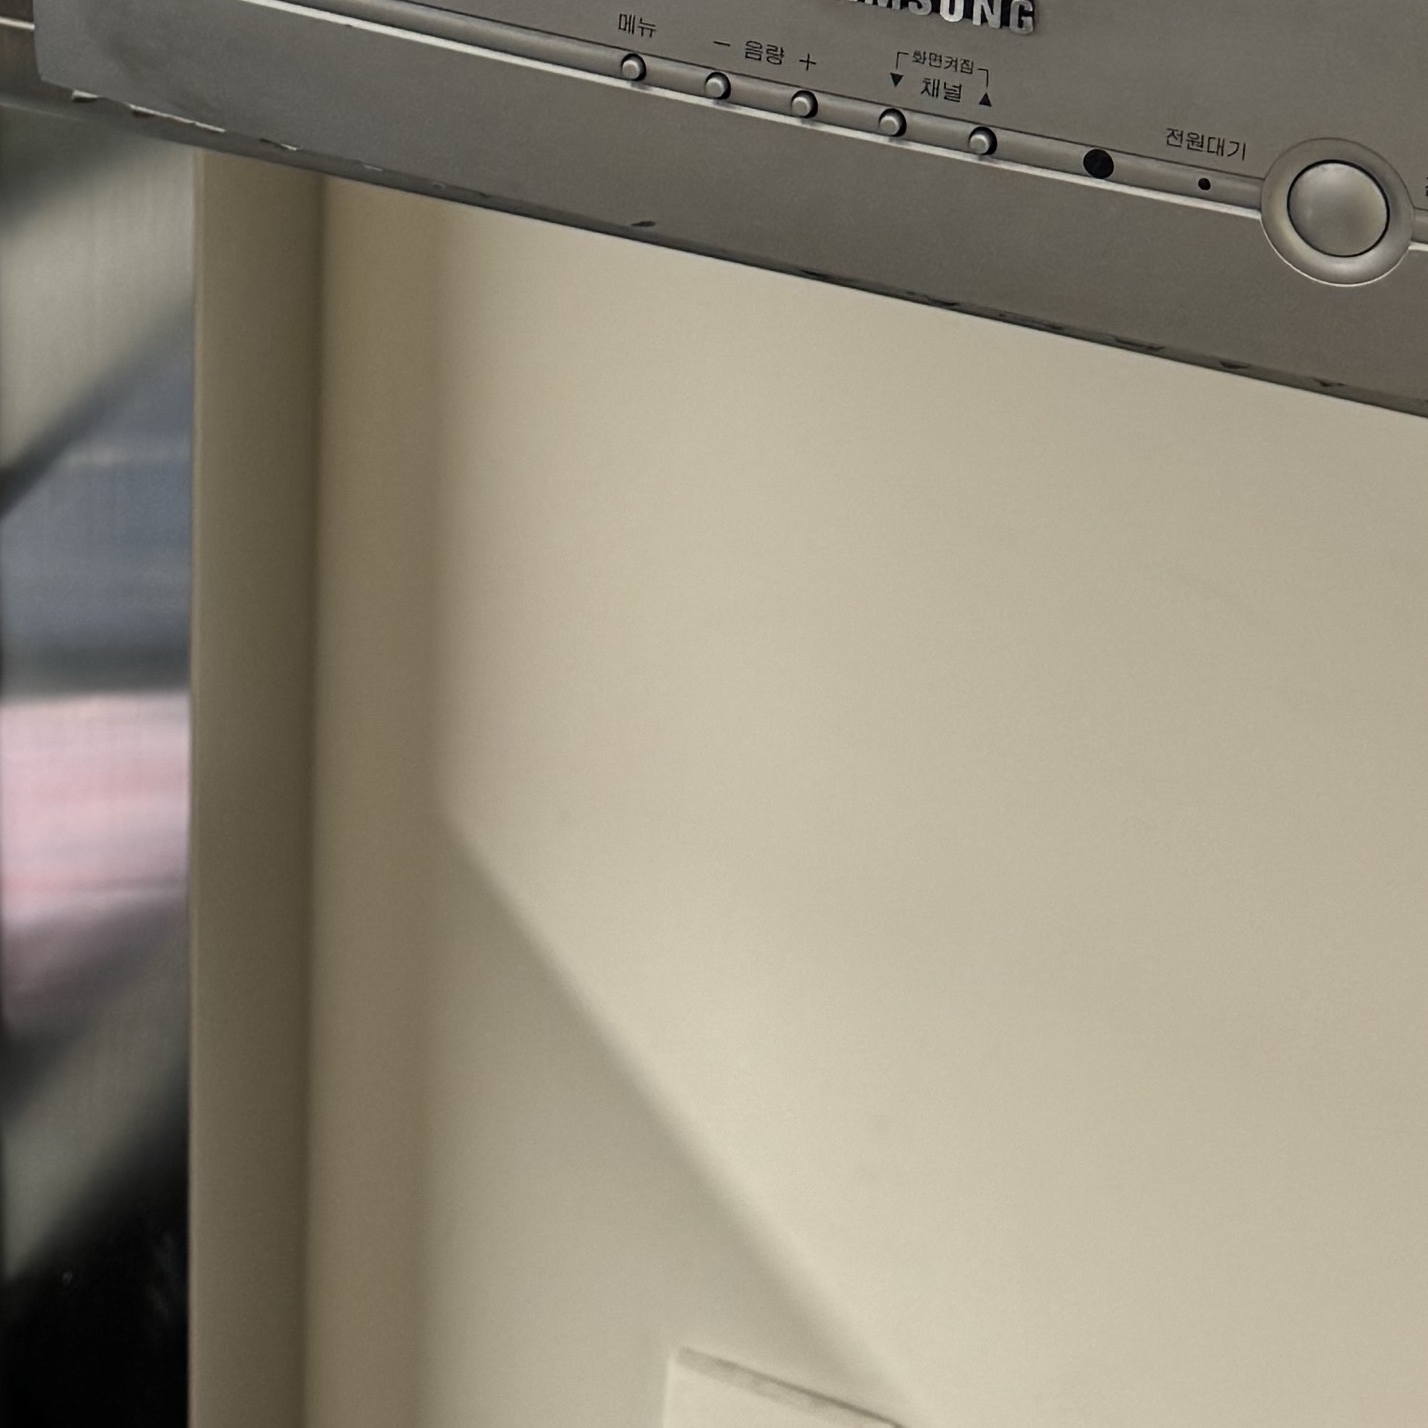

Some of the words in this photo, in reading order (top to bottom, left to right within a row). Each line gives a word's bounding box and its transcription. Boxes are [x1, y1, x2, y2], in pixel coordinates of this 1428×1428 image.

[618, 13, 657, 38] 메뉴
[745, 40, 785, 65] 음량
[920, 77, 962, 103] 채널
[1166, 127, 1246, 161] 전원대기
